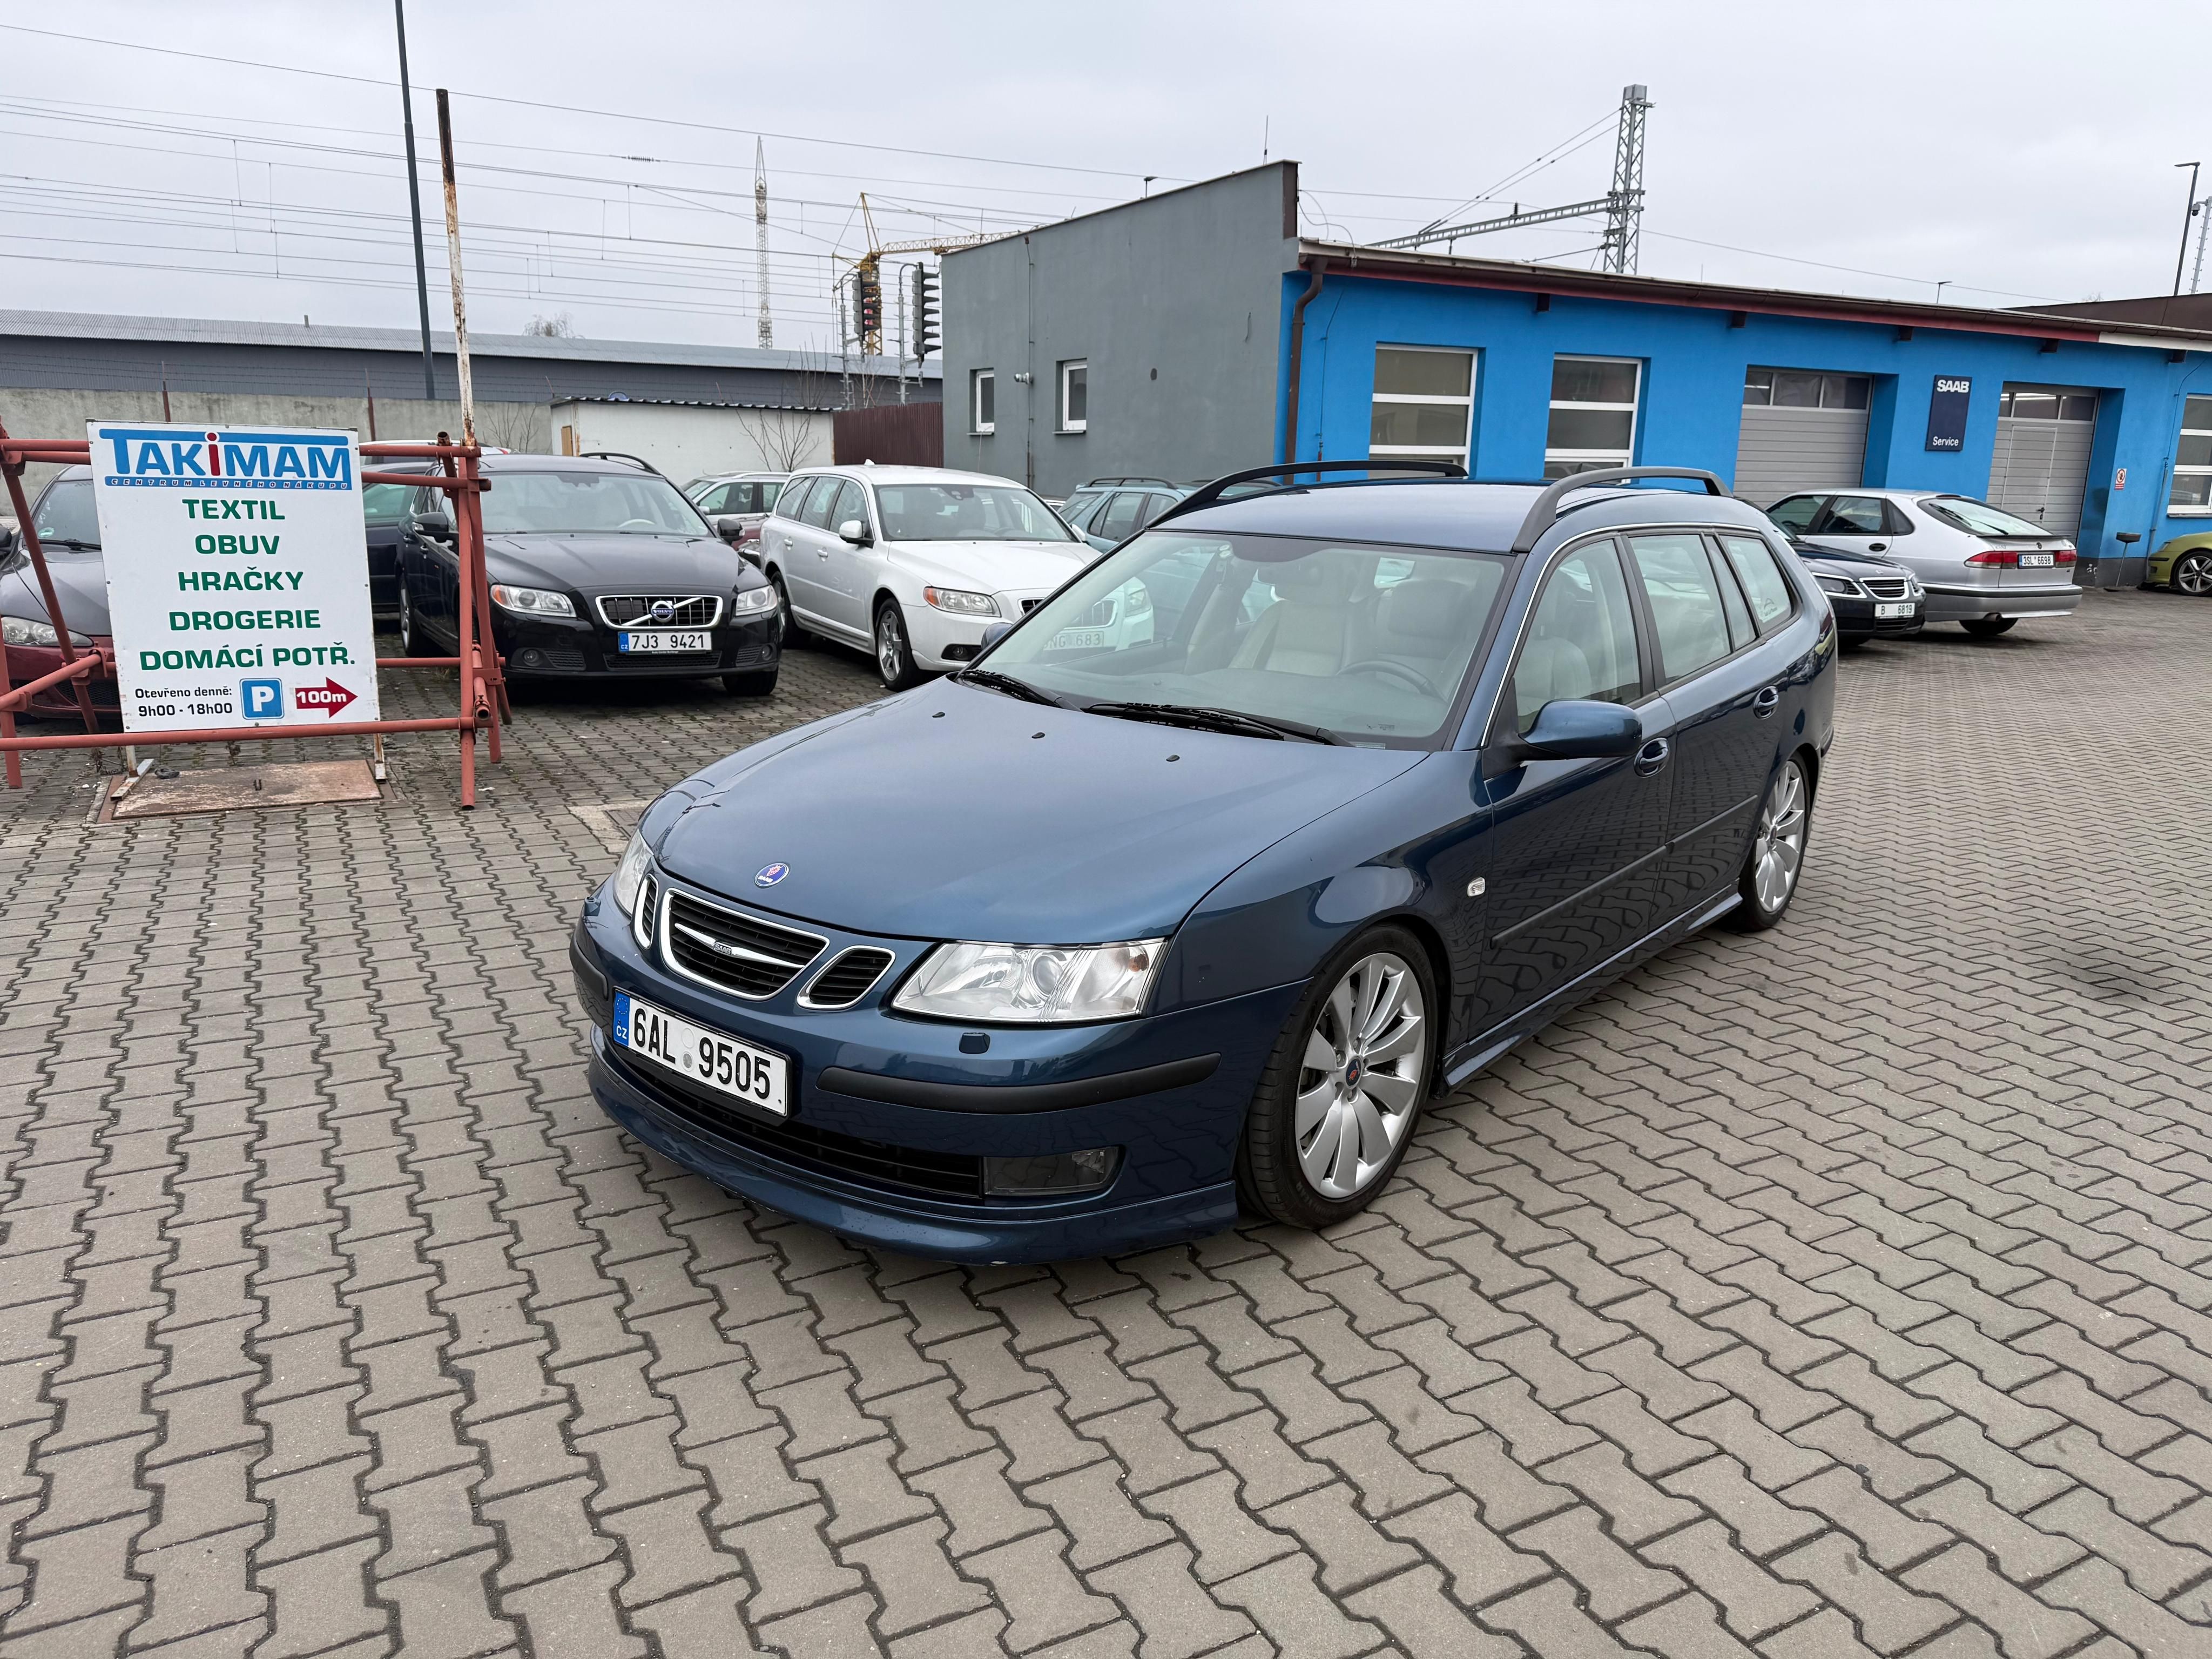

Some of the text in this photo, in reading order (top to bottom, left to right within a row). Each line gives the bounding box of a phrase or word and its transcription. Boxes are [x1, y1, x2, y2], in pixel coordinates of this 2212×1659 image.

[1937, 379, 1970, 393] SAAB
[1933, 436, 1959, 446] Service
[111, 478, 348, 489] CENTRUM LEVNÉHO NÁKUPU
[182, 498, 285, 520] TEXTIL
[195, 535, 280, 555] OBUV
[2024, 556, 2051, 565] 3SL 6698
[178, 566, 304, 591] HRAČKY
[169, 609, 321, 631] DROGERIE
[632, 634, 704, 649] 7J3 9421
[1076, 633, 1100, 646] 683
[139, 641, 355, 670] DOMÁCÍ POTŘ.
[135, 685, 232, 699] Otevřeno denně:
[296, 690, 347, 704] 100m
[138, 705, 176, 717] 9h00
[187, 702, 233, 716] 18h00
[714, 943, 732, 954] SAAB
[616, 1024, 628, 1040] CZ
[634, 1008, 771, 1100] 6AL 9505
